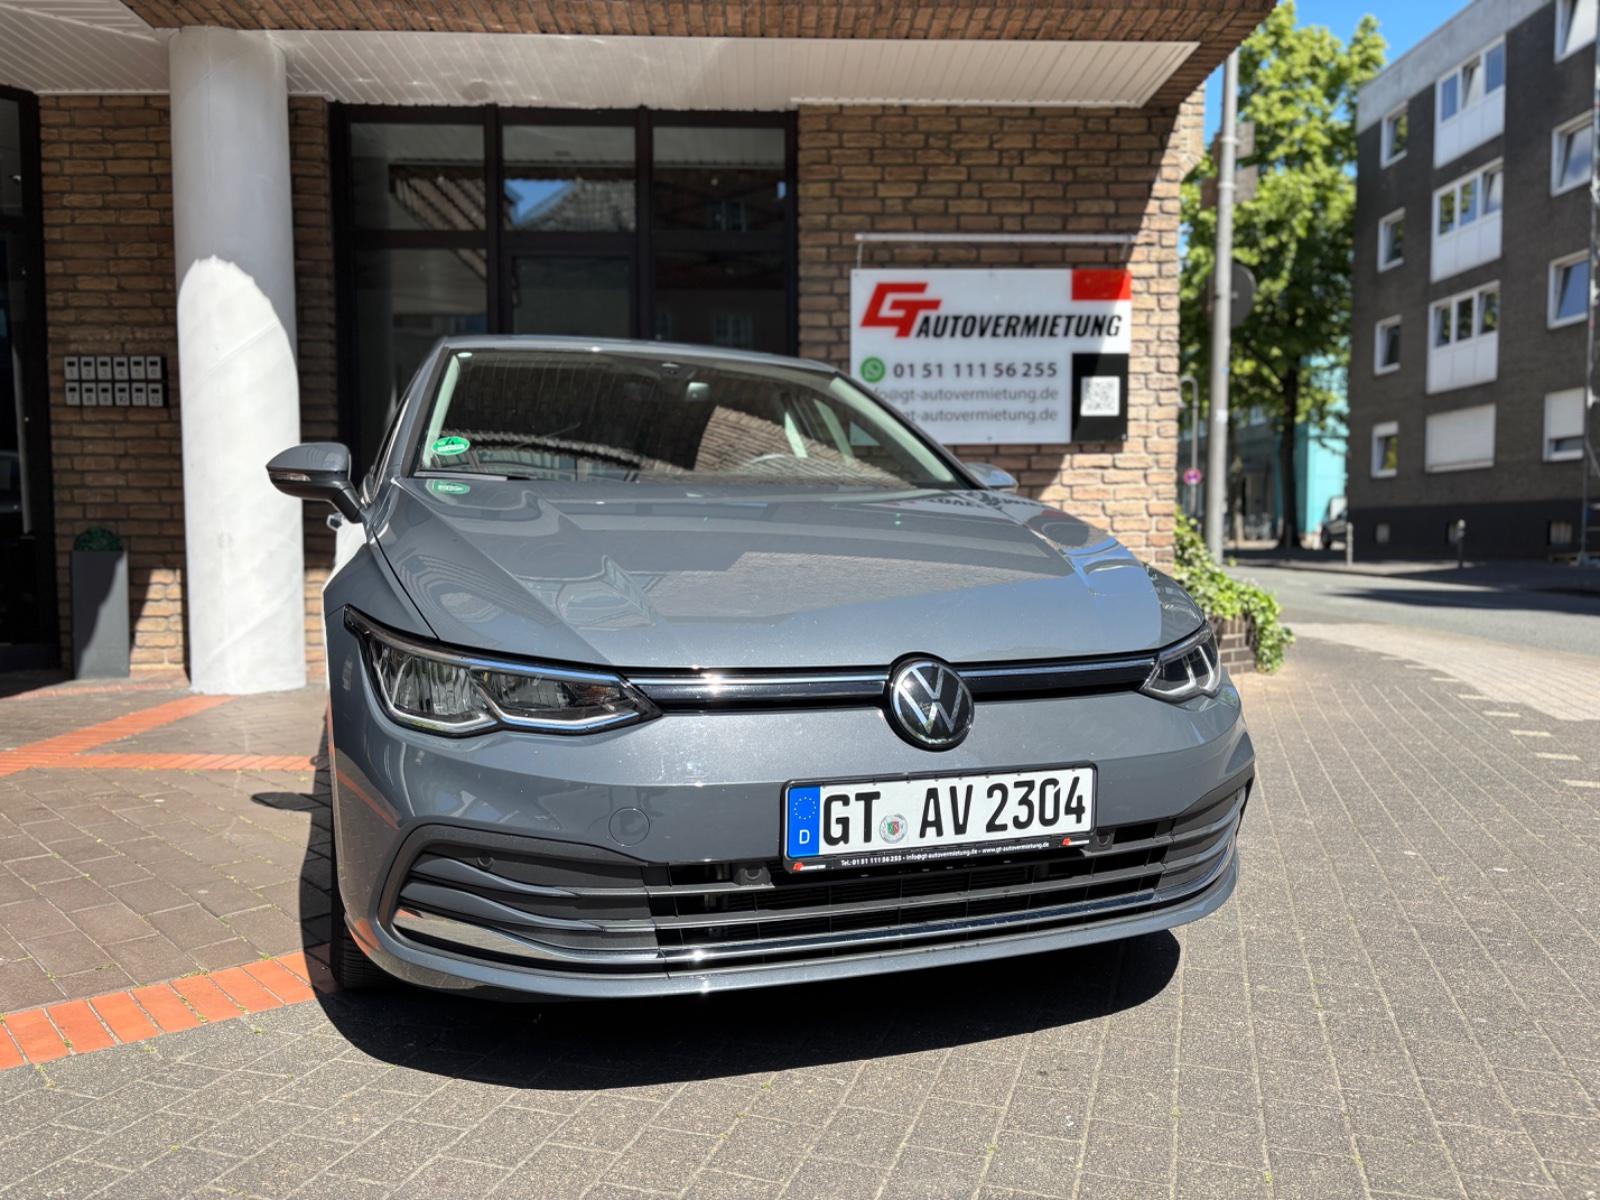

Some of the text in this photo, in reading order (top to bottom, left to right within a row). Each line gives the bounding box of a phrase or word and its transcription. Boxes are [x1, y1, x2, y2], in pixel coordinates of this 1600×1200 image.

[915, 314, 1122, 338] AUTOVERMIETUNG
[823, 776, 1086, 846] GT AV 2304
[798, 829, 811, 845] D
